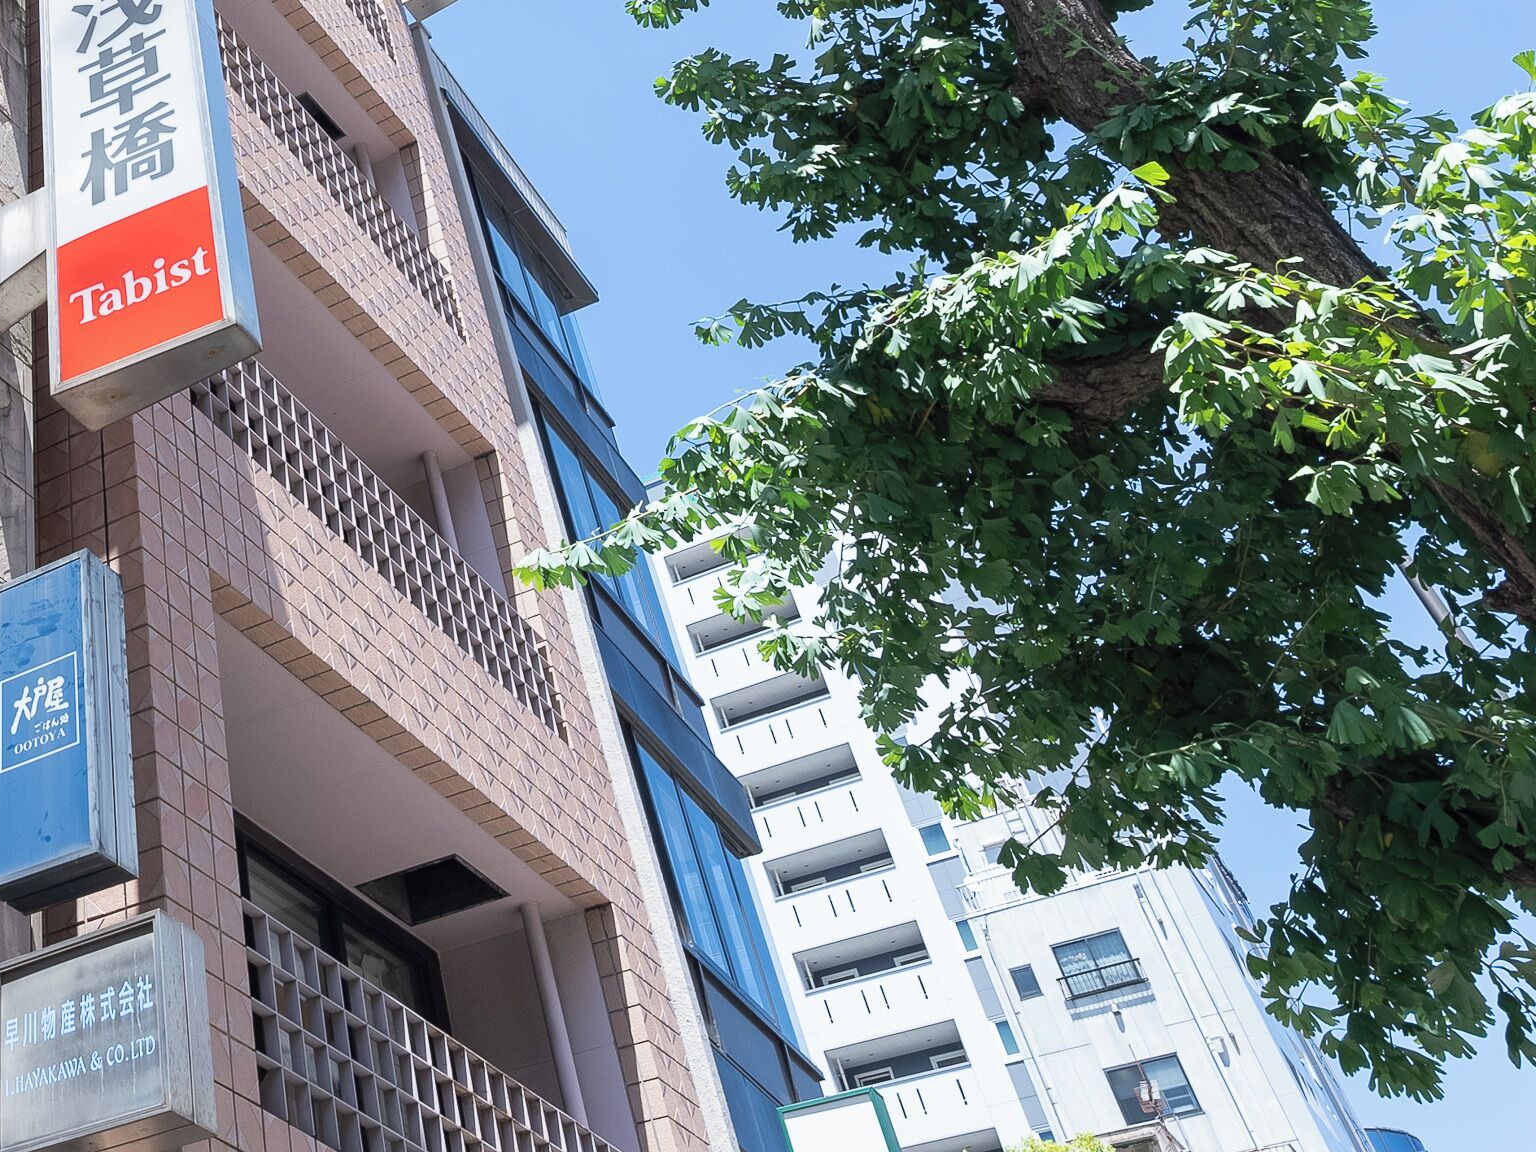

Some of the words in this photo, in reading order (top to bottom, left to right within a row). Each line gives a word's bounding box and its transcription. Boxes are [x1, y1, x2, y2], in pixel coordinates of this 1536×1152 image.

[69, 245, 211, 325] Tabist
[10, 675, 70, 736] 大戸屋
[14, 727, 66, 755] OOTOYA
[5, 974, 154, 1052] 早川物産株式会社
[90, 1051, 103, 1071] &
